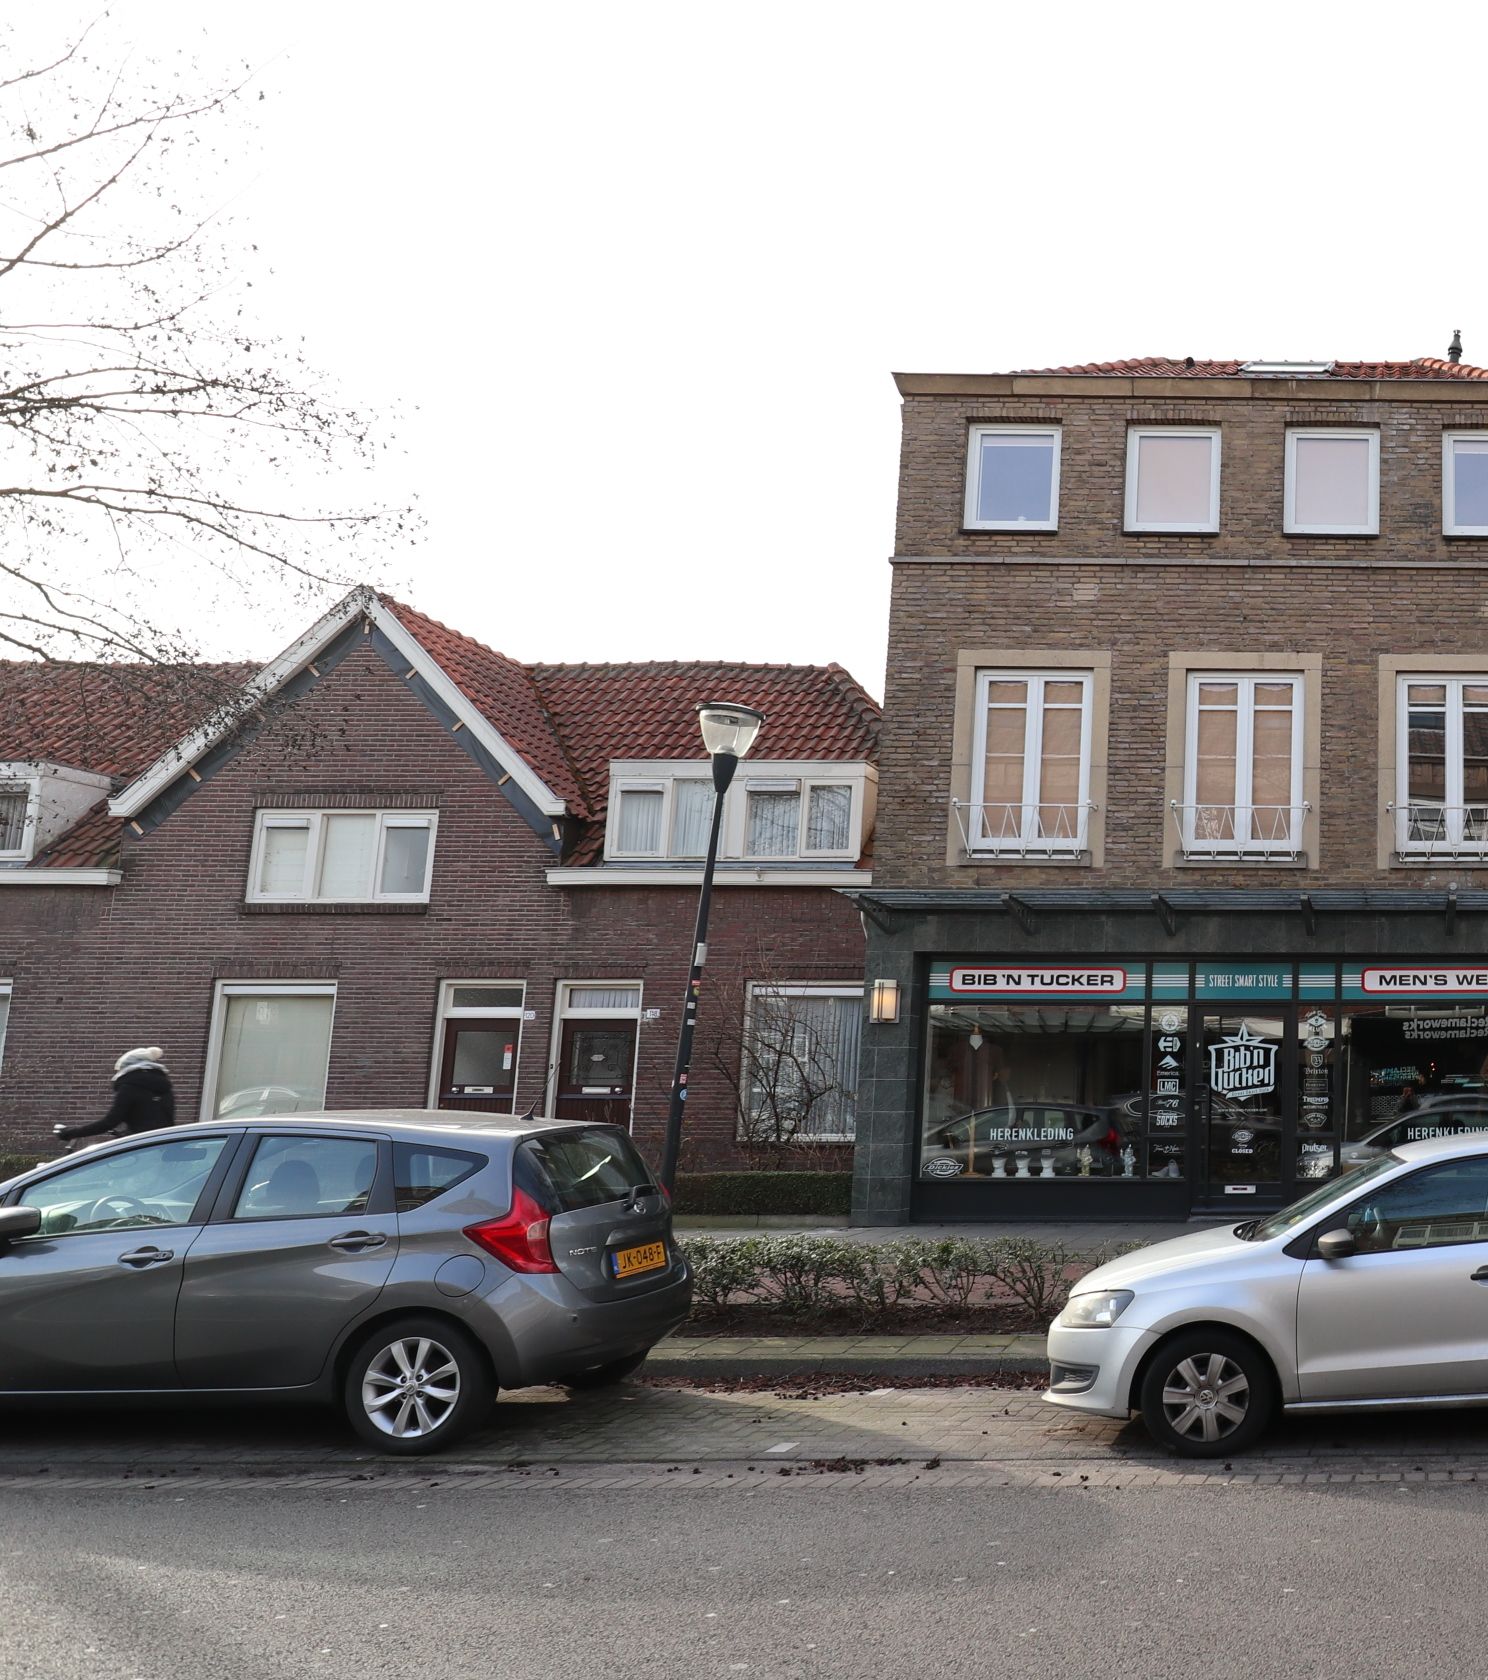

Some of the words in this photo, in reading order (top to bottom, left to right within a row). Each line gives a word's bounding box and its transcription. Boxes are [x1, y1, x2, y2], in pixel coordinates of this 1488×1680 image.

[961, 973, 998, 986] BIB
[1001, 973, 1022, 986] 'N
[1027, 973, 1114, 987] TUCKER
[1209, 974, 1233, 988] STREET
[1234, 974, 1257, 988] SMART
[1258, 974, 1279, 988] STYLE
[1378, 973, 1448, 986] MEN'S
[1223, 1045, 1264, 1072] Bib'n
[1215, 1066, 1275, 1093] Tucker
[1159, 1081, 1177, 1092] LMC
[1156, 1115, 1178, 1126] SOCKS
[990, 1127, 1074, 1140] HERENKLEDING
[569, 1246, 597, 1256] NOTE
[622, 1245, 662, 1269] JK-048-F
